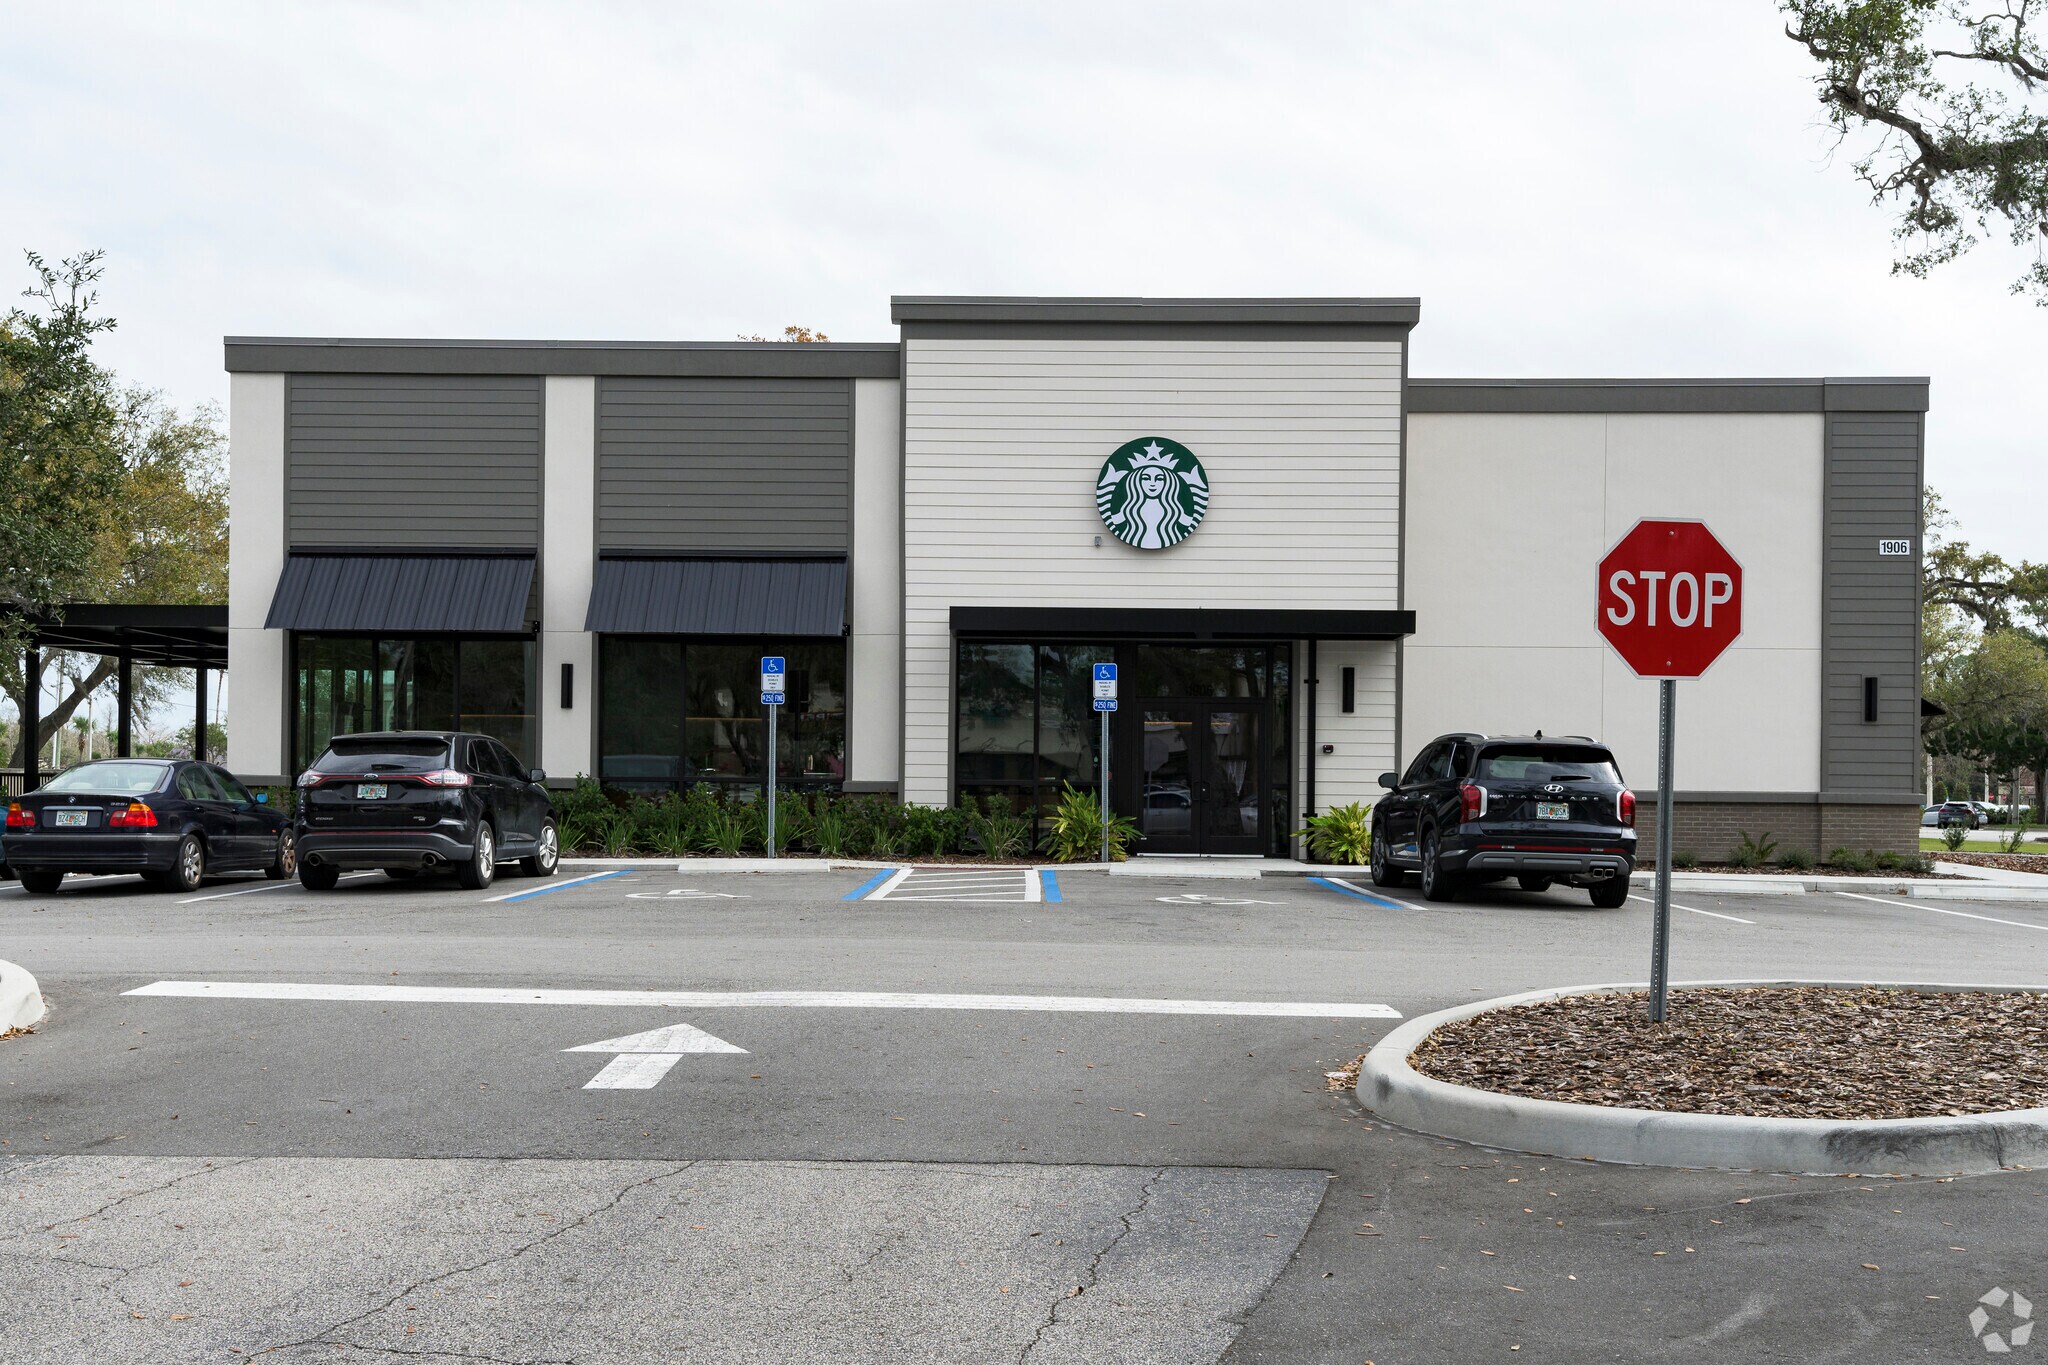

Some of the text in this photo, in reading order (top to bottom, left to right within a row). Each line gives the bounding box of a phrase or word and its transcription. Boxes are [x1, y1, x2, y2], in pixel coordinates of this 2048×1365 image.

[1881, 541, 1907, 553] 1906
[1606, 569, 1733, 627] STOP
[1095, 701, 1116, 709] $250 FINE
